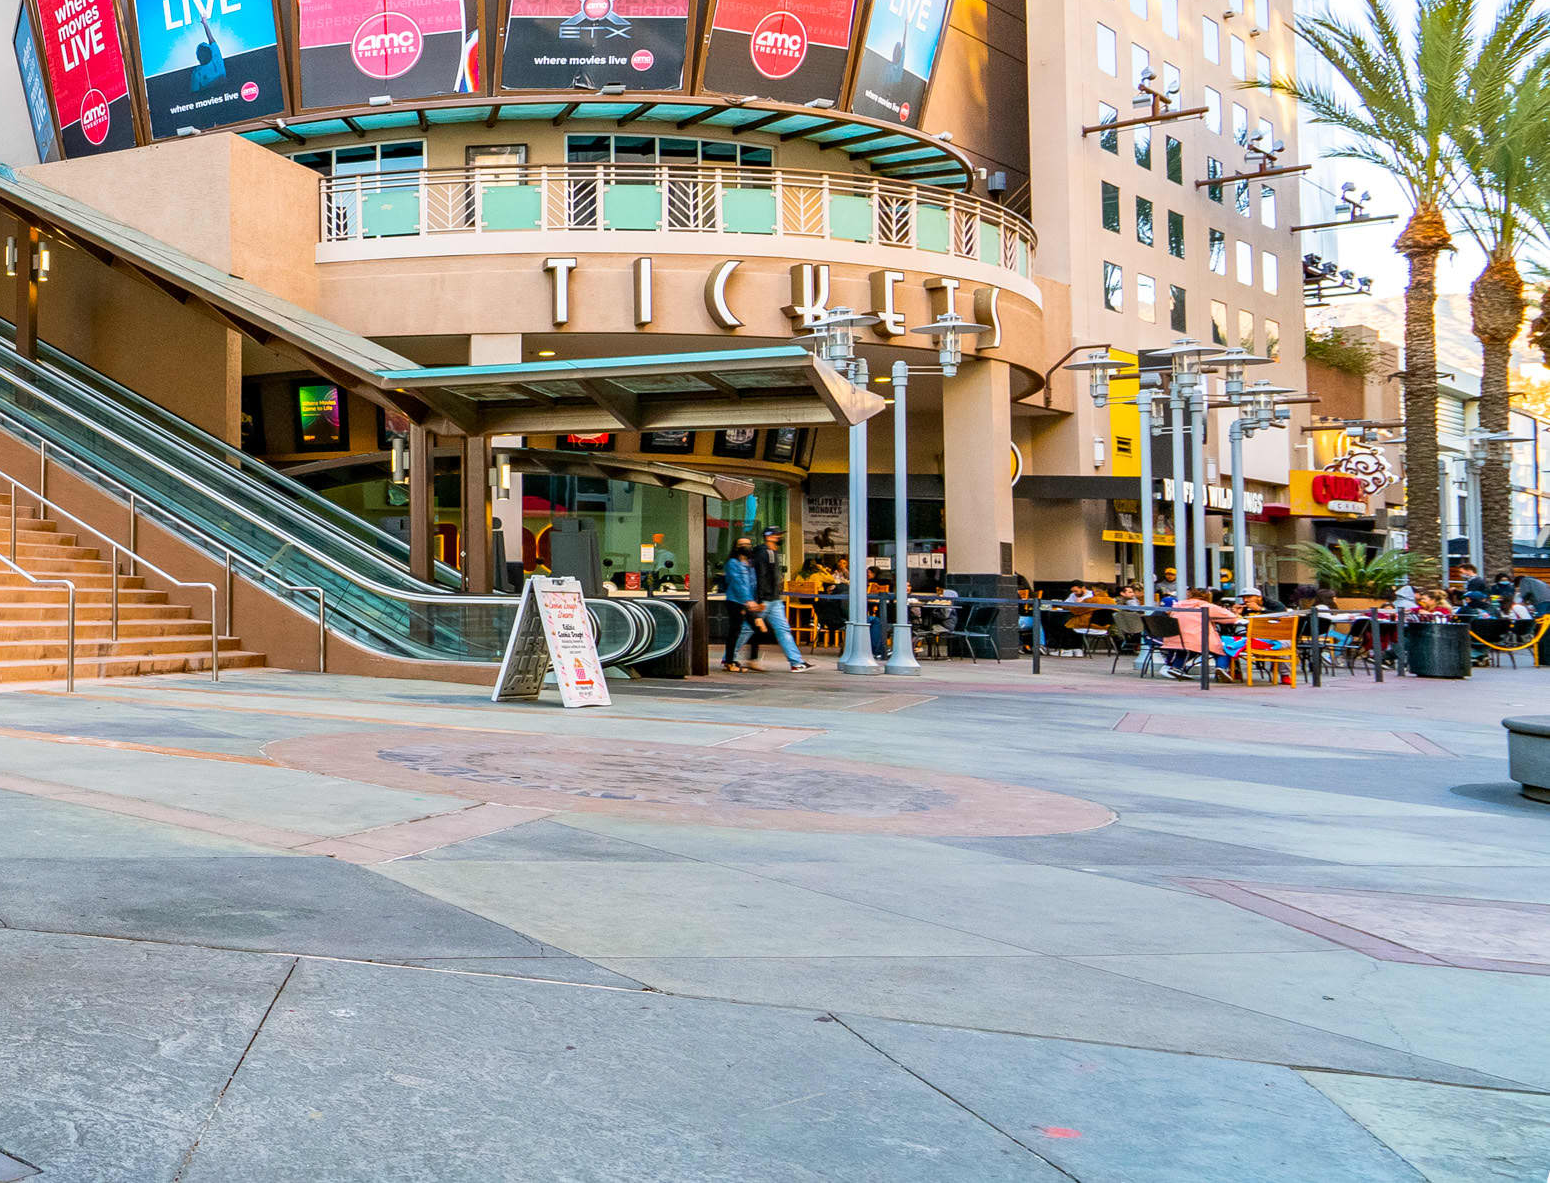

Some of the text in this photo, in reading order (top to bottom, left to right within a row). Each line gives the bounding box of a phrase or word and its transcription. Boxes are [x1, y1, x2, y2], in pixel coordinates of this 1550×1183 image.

[57, 4, 100, 43] movies
[558, 25, 633, 39] ETX
[60, 19, 106, 73] LIVE
[357, 30, 415, 51] amc
[755, 31, 802, 50] amc
[755, 44, 800, 58] THEATRES
[358, 47, 417, 58] THEATRES
[534, 55, 627, 65] where movies live
[83, 102, 107, 124] amc
[170, 91, 239, 115] where movies live
[542, 256, 1001, 351] TICKETS
[1243, 491, 1264, 514] INGS
